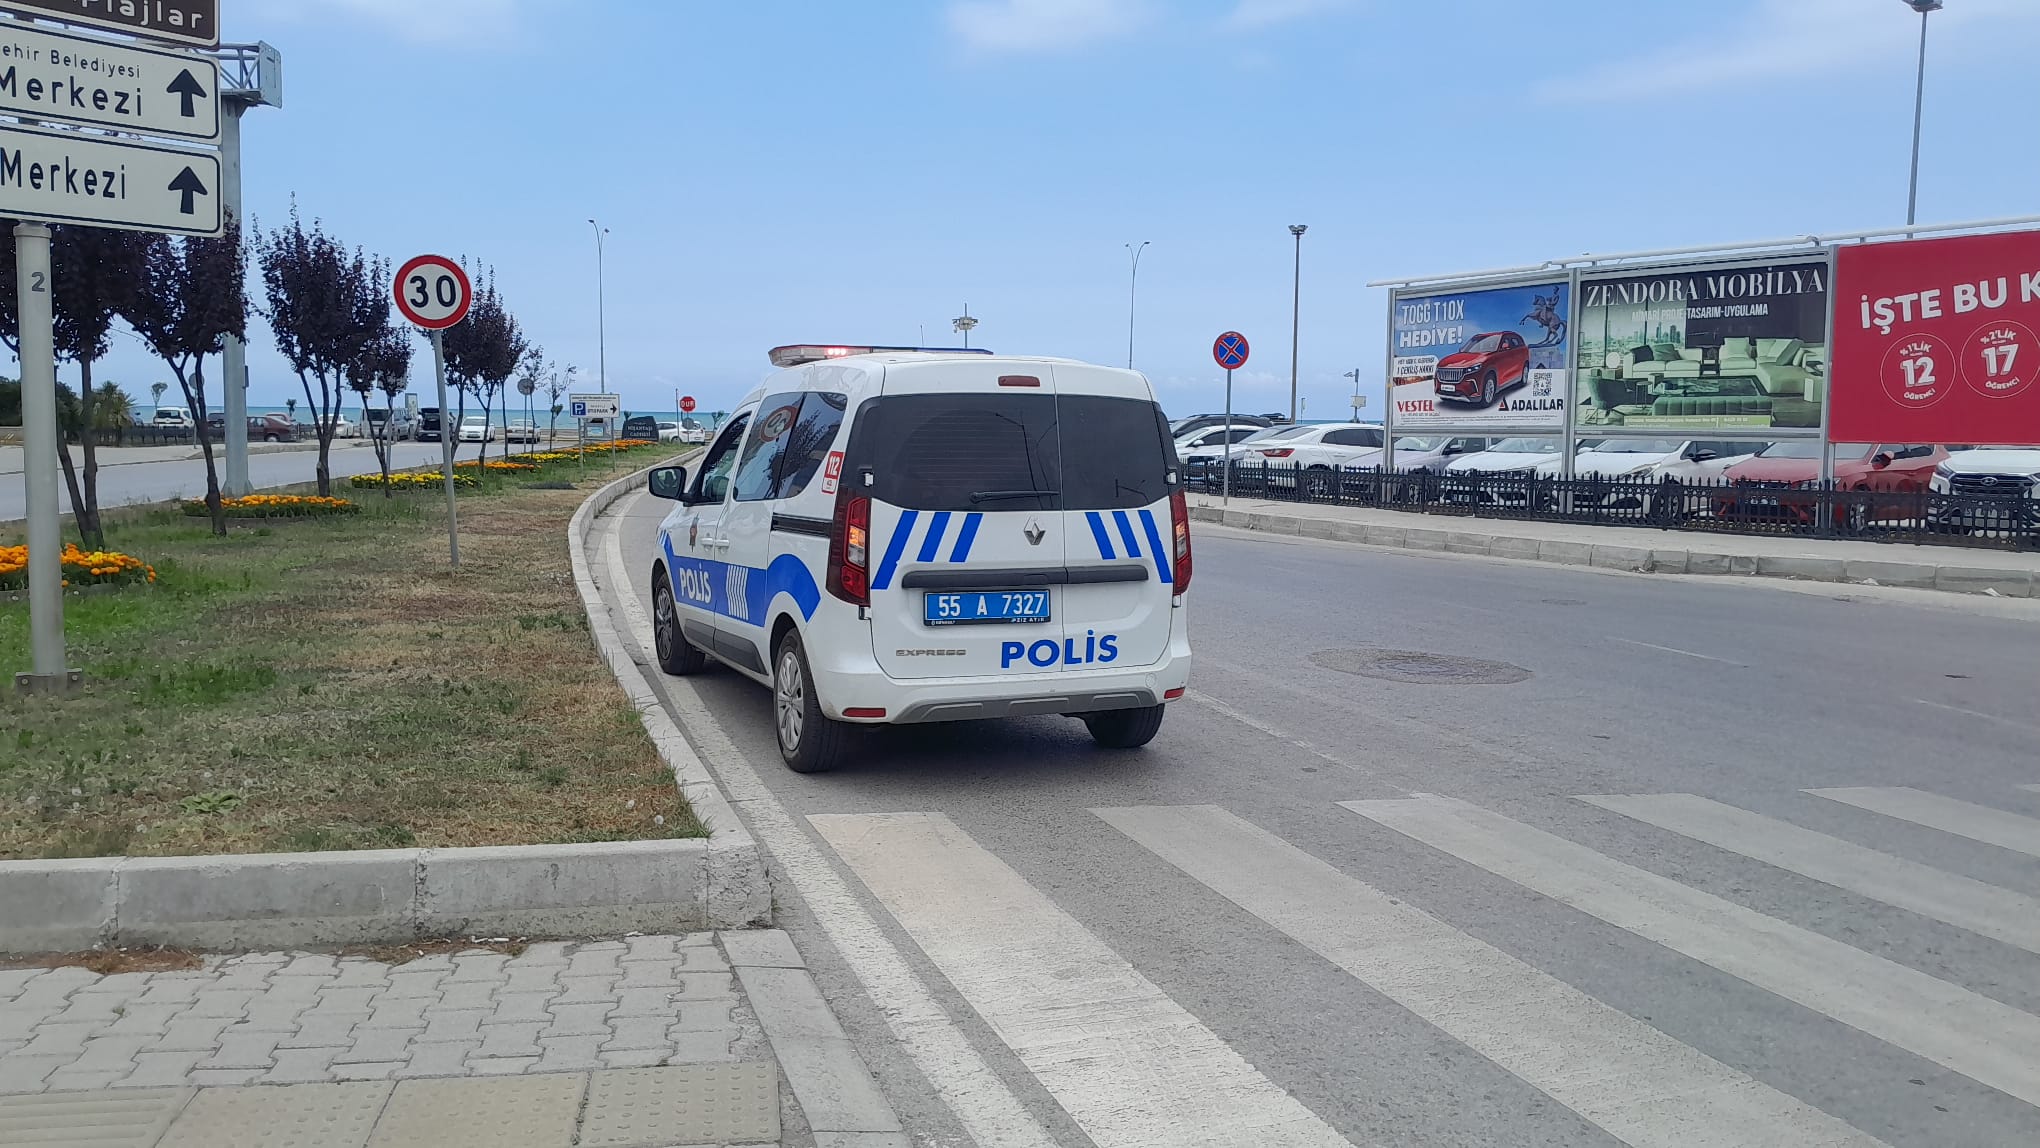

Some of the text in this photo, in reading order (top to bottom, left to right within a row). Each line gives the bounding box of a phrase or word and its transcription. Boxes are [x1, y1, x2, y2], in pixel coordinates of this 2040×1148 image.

[2, 43, 141, 79] ehir Belediyesi
[0, 65, 142, 117] Merkezi
[0, 149, 126, 200] Merkezi
[31, 271, 46, 292] 2
[410, 275, 456, 308] 30
[1586, 267, 1825, 307] ZENDORA MOBİLYA
[1402, 300, 1465, 325] TOGG T10X
[1687, 304, 1769, 319] TASARIM-UYGULAMA
[1860, 289, 1942, 335] İŞTE
[1953, 277, 2008, 313] BU
[1400, 324, 1463, 348] HEDİYE!
[1901, 357, 1936, 387] 12
[1981, 344, 2019, 377] 17
[1397, 400, 1434, 412] VESTEL
[1511, 399, 1564, 411] ADALILAR
[827, 455, 841, 476] 112
[679, 562, 712, 604] POLİS
[939, 593, 1045, 617] 55 A 7327
[1000, 629, 1118, 669] POLİS
